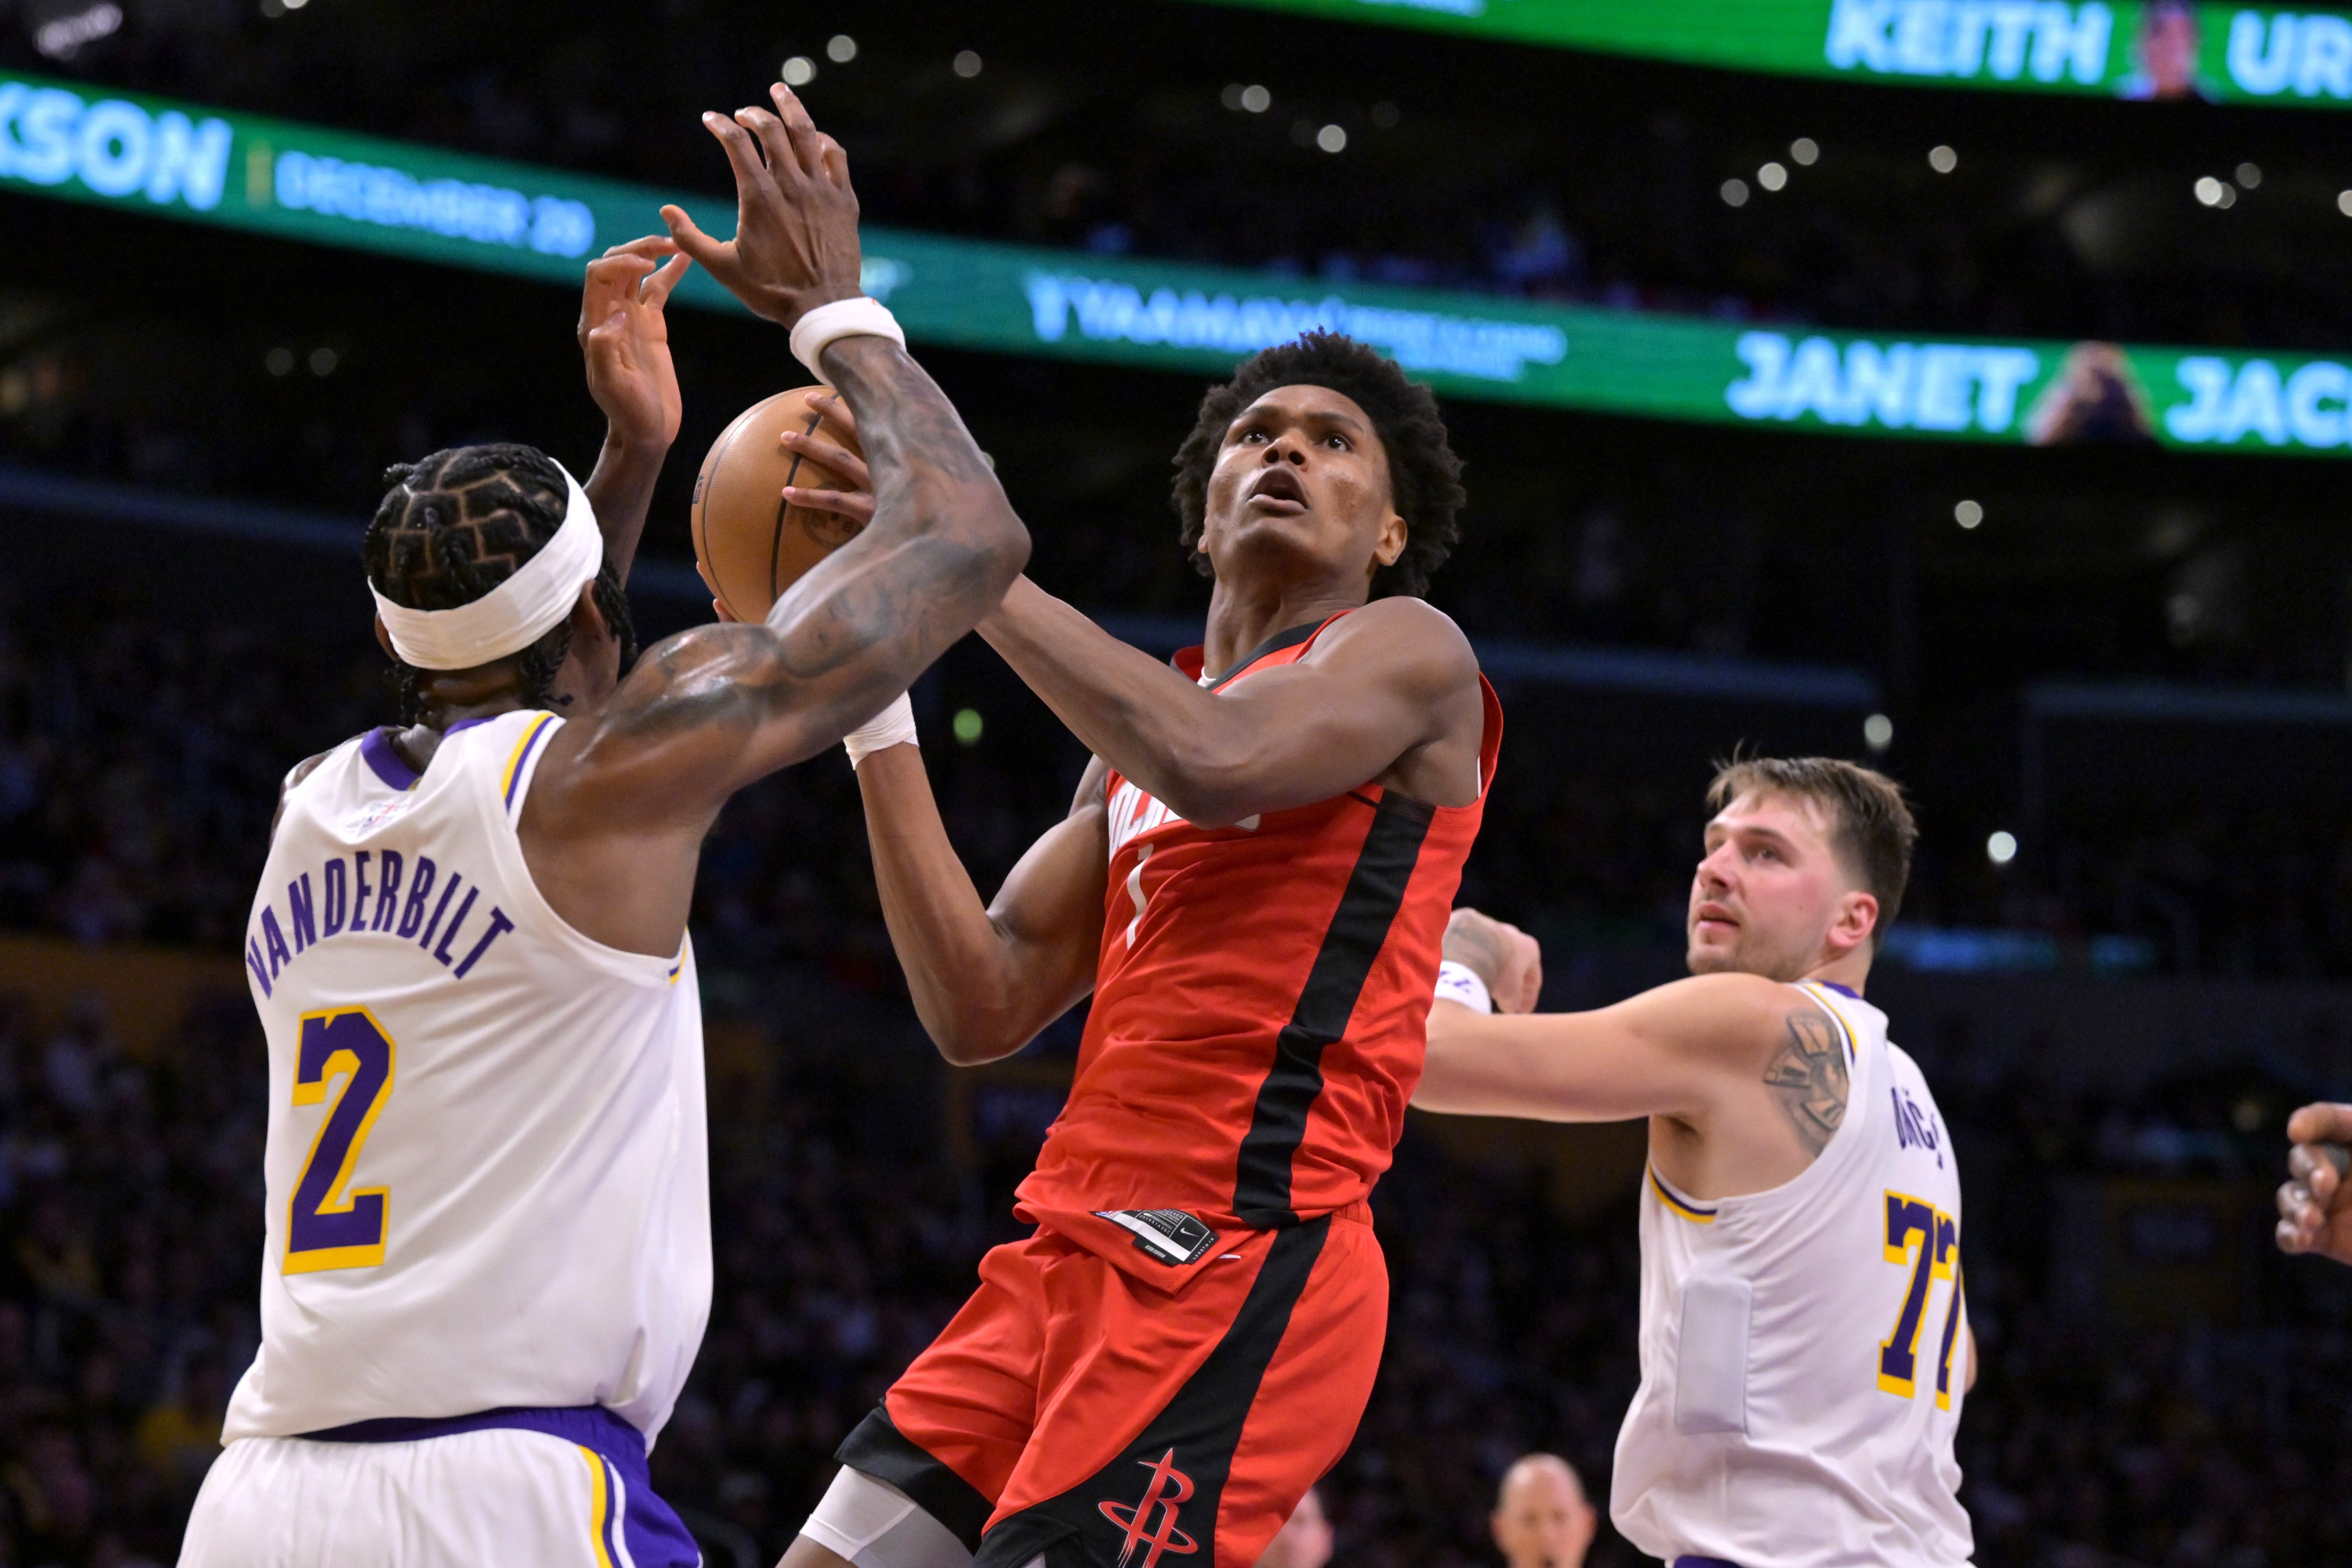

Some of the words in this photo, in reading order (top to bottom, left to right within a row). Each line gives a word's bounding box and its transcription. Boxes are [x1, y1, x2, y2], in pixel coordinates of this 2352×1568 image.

[1824, 0, 2112, 85] KEITH
[1725, 331, 2040, 433] JANET
[2165, 357, 2352, 450] JAC
[247, 850, 515, 1000] VANDERBILT
[281, 1004, 396, 1275] 2
[1877, 1189, 1964, 1412] 77
